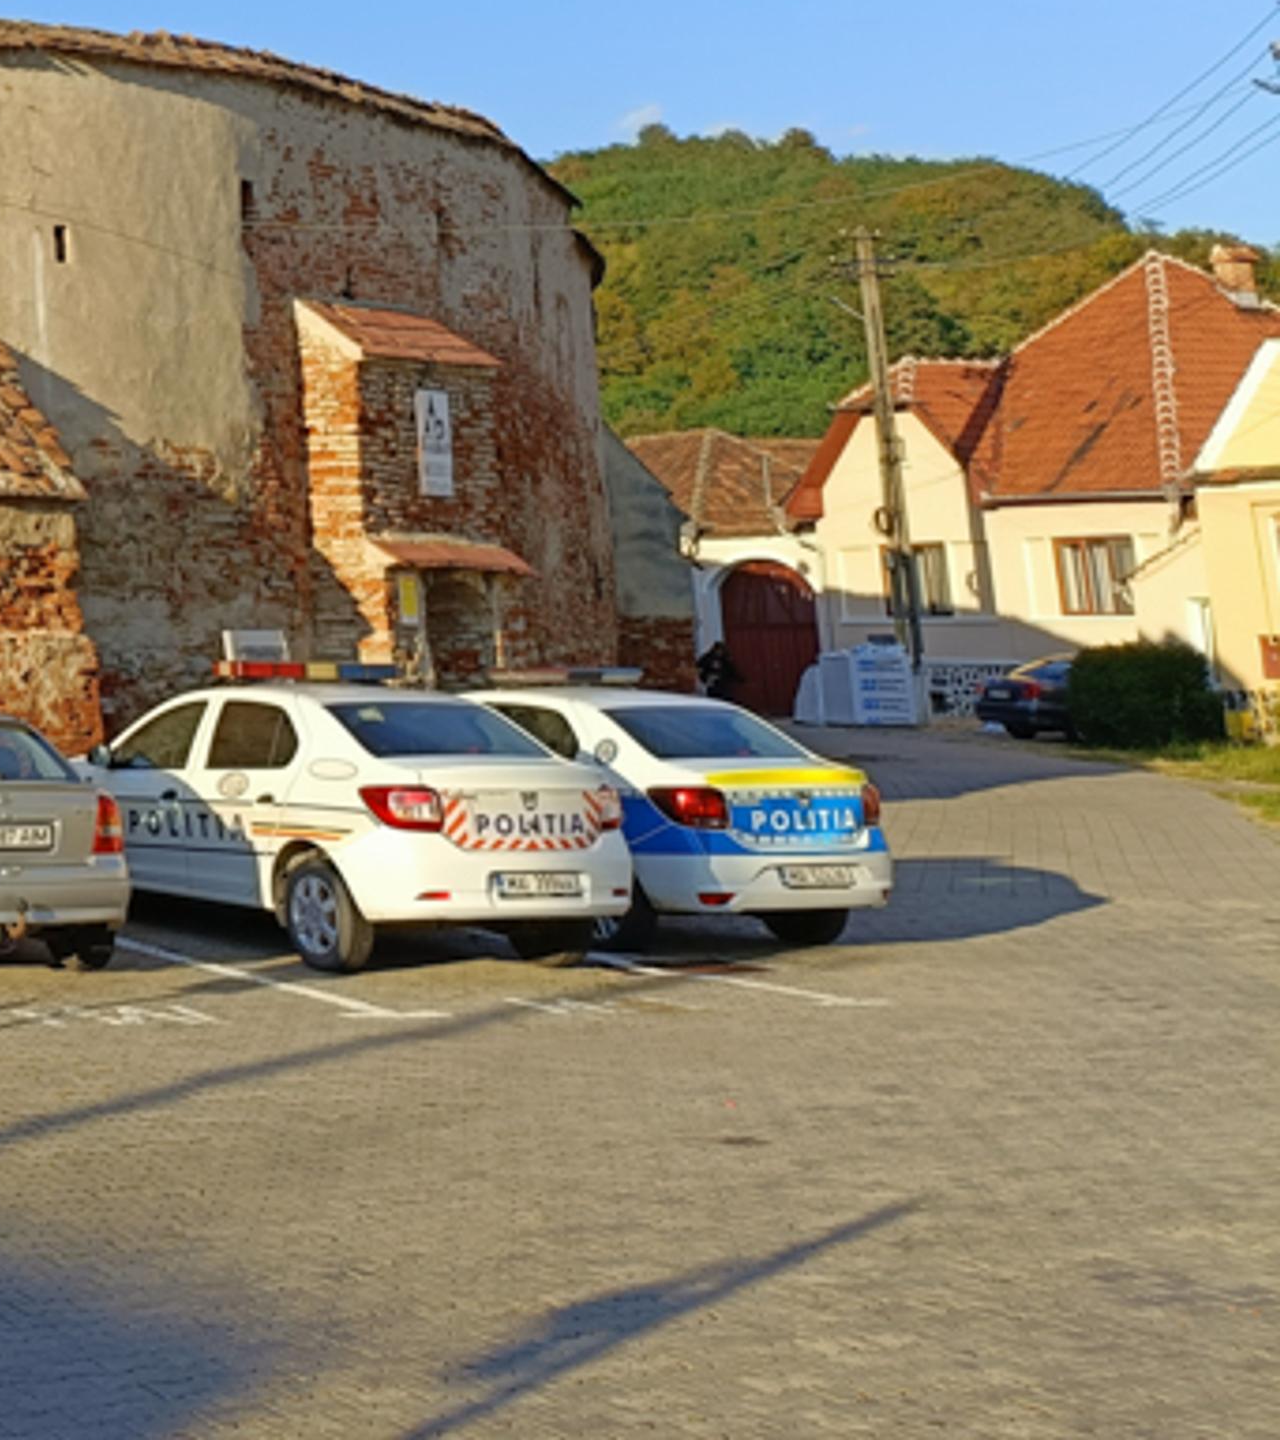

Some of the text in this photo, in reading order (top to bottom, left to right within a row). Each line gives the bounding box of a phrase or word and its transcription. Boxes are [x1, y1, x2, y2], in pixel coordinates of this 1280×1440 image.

[128, 808, 248, 842] POLITIA
[474, 812, 585, 837] POLITIA
[750, 807, 858, 833] POLITIA
